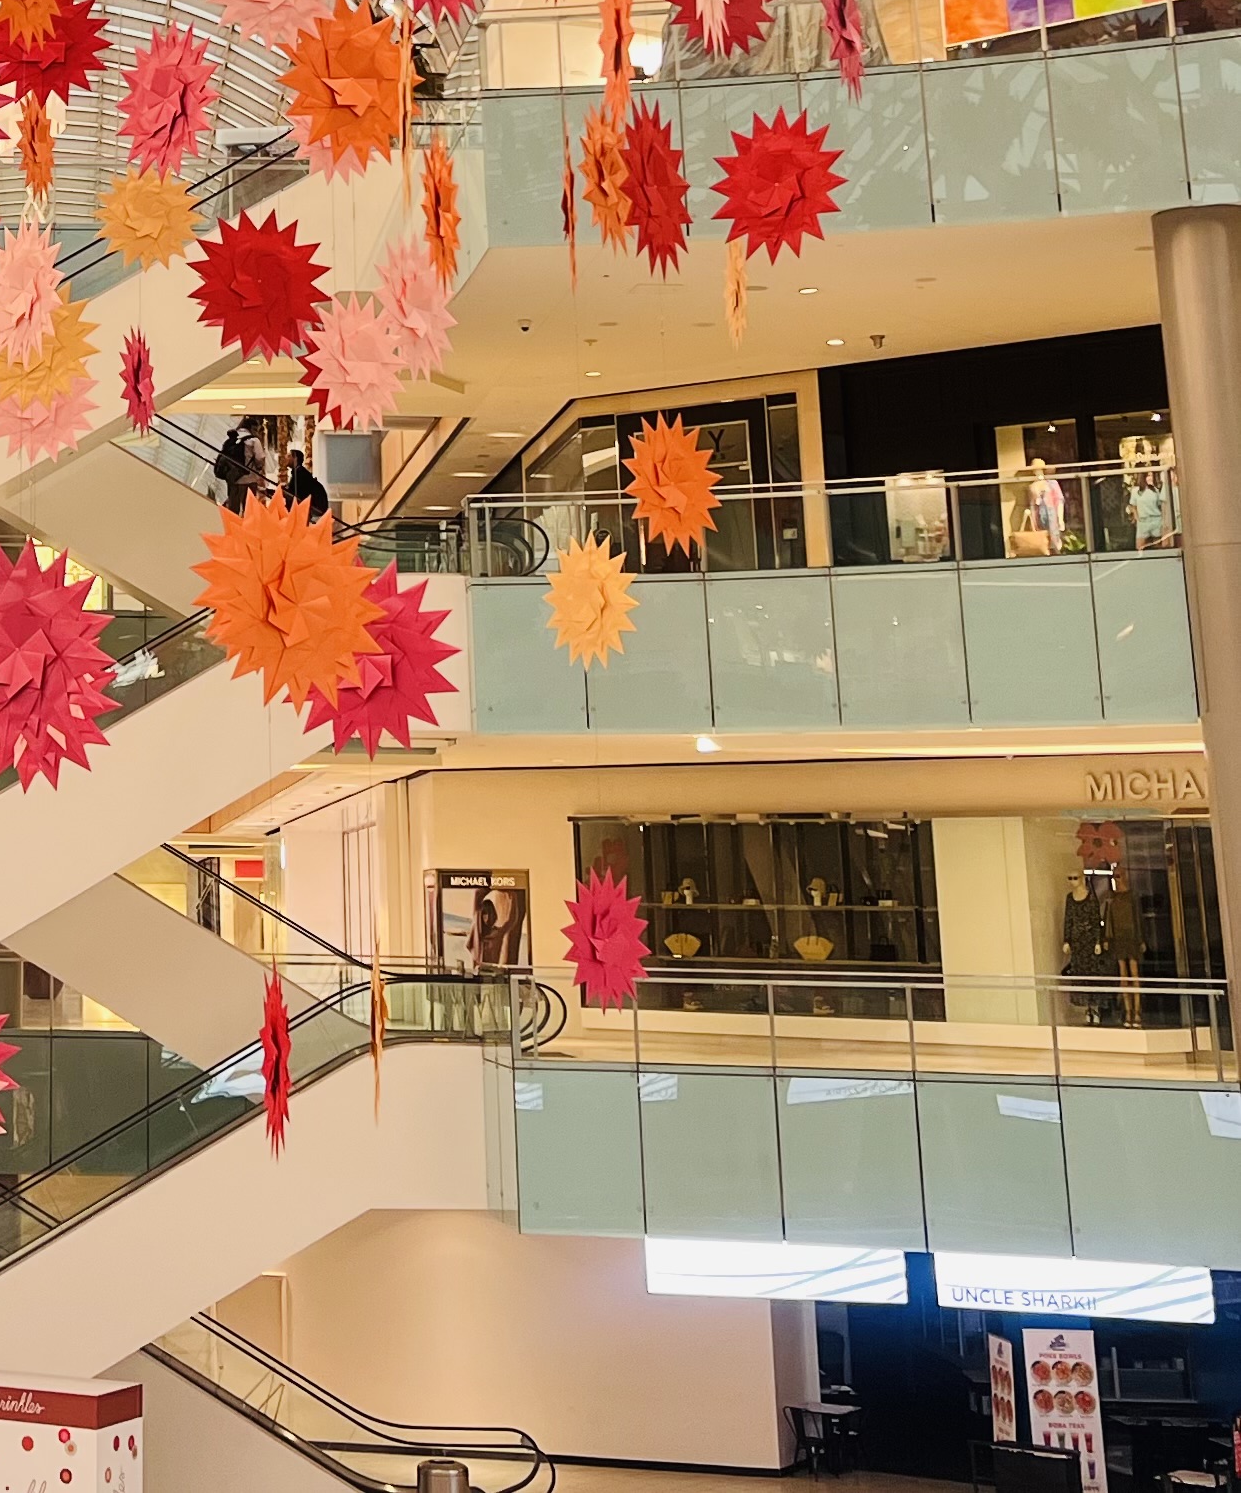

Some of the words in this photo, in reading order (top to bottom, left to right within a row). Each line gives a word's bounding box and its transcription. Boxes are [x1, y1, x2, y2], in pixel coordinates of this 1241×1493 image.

[1085, 768, 1209, 802] MICHA
[450, 876, 489, 887] MICHAEL
[490, 876, 516, 887] KORS
[951, 1287, 1015, 1306] UNCLE
[1021, 1291, 1097, 1311] SHARKII
